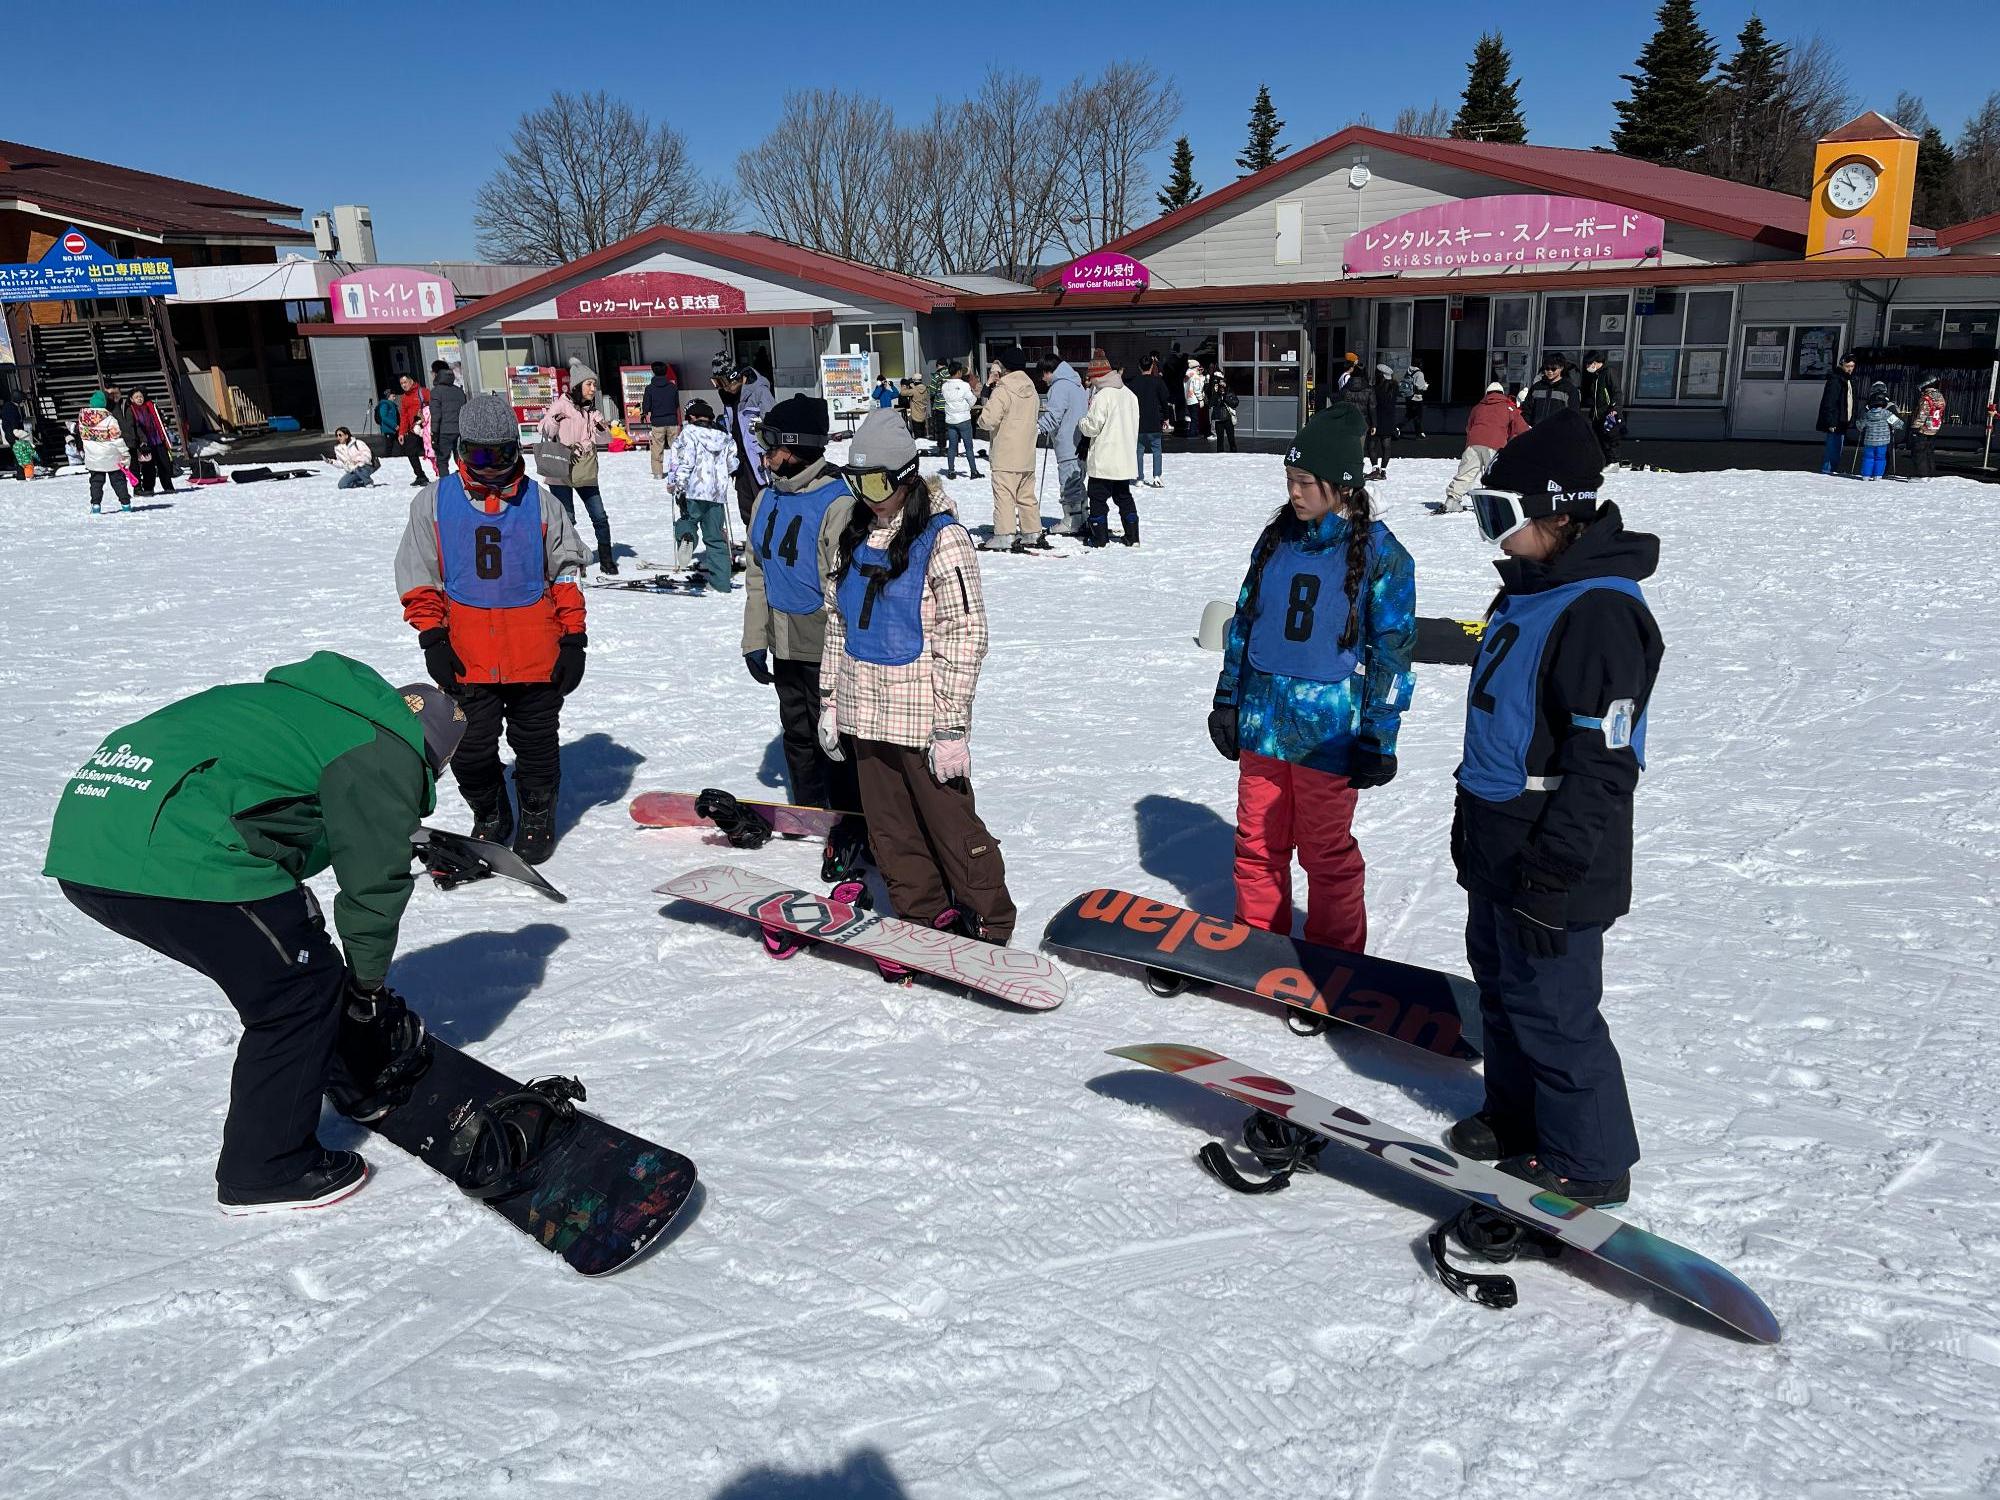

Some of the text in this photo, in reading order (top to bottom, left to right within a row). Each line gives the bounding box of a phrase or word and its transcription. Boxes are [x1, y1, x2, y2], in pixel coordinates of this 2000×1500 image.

[1365, 214, 1640, 251] レンタルスキー・スノーボード
[1383, 244, 1613, 267] Ski&Snowboard Rentals
[44, 266, 85, 277] ヨーデル
[88, 261, 171, 277] 出口専用階段
[1074, 263, 1135, 278] レンタル受付
[1, 276, 76, 287] Restaurant Yodel
[368, 282, 413, 303] トイレ
[1067, 281, 1086, 289] Snow
[1086, 280, 1102, 288] Gear
[1103, 278, 1125, 288] Rental
[372, 306, 417, 318] Toilet
[896, 463, 916, 480] HEAD
[1552, 491, 1598, 511] FLY DRE
[762, 509, 803, 567] 14
[475, 525, 503, 580] 6
[858, 562, 891, 630] 7
[1284, 572, 1322, 643] 8
[1471, 621, 1520, 715] 2
[73, 768, 152, 791] i&Snowboard
[74, 783, 110, 798] School
[1077, 888, 1251, 954] elan
[1255, 964, 1462, 1058] elan
